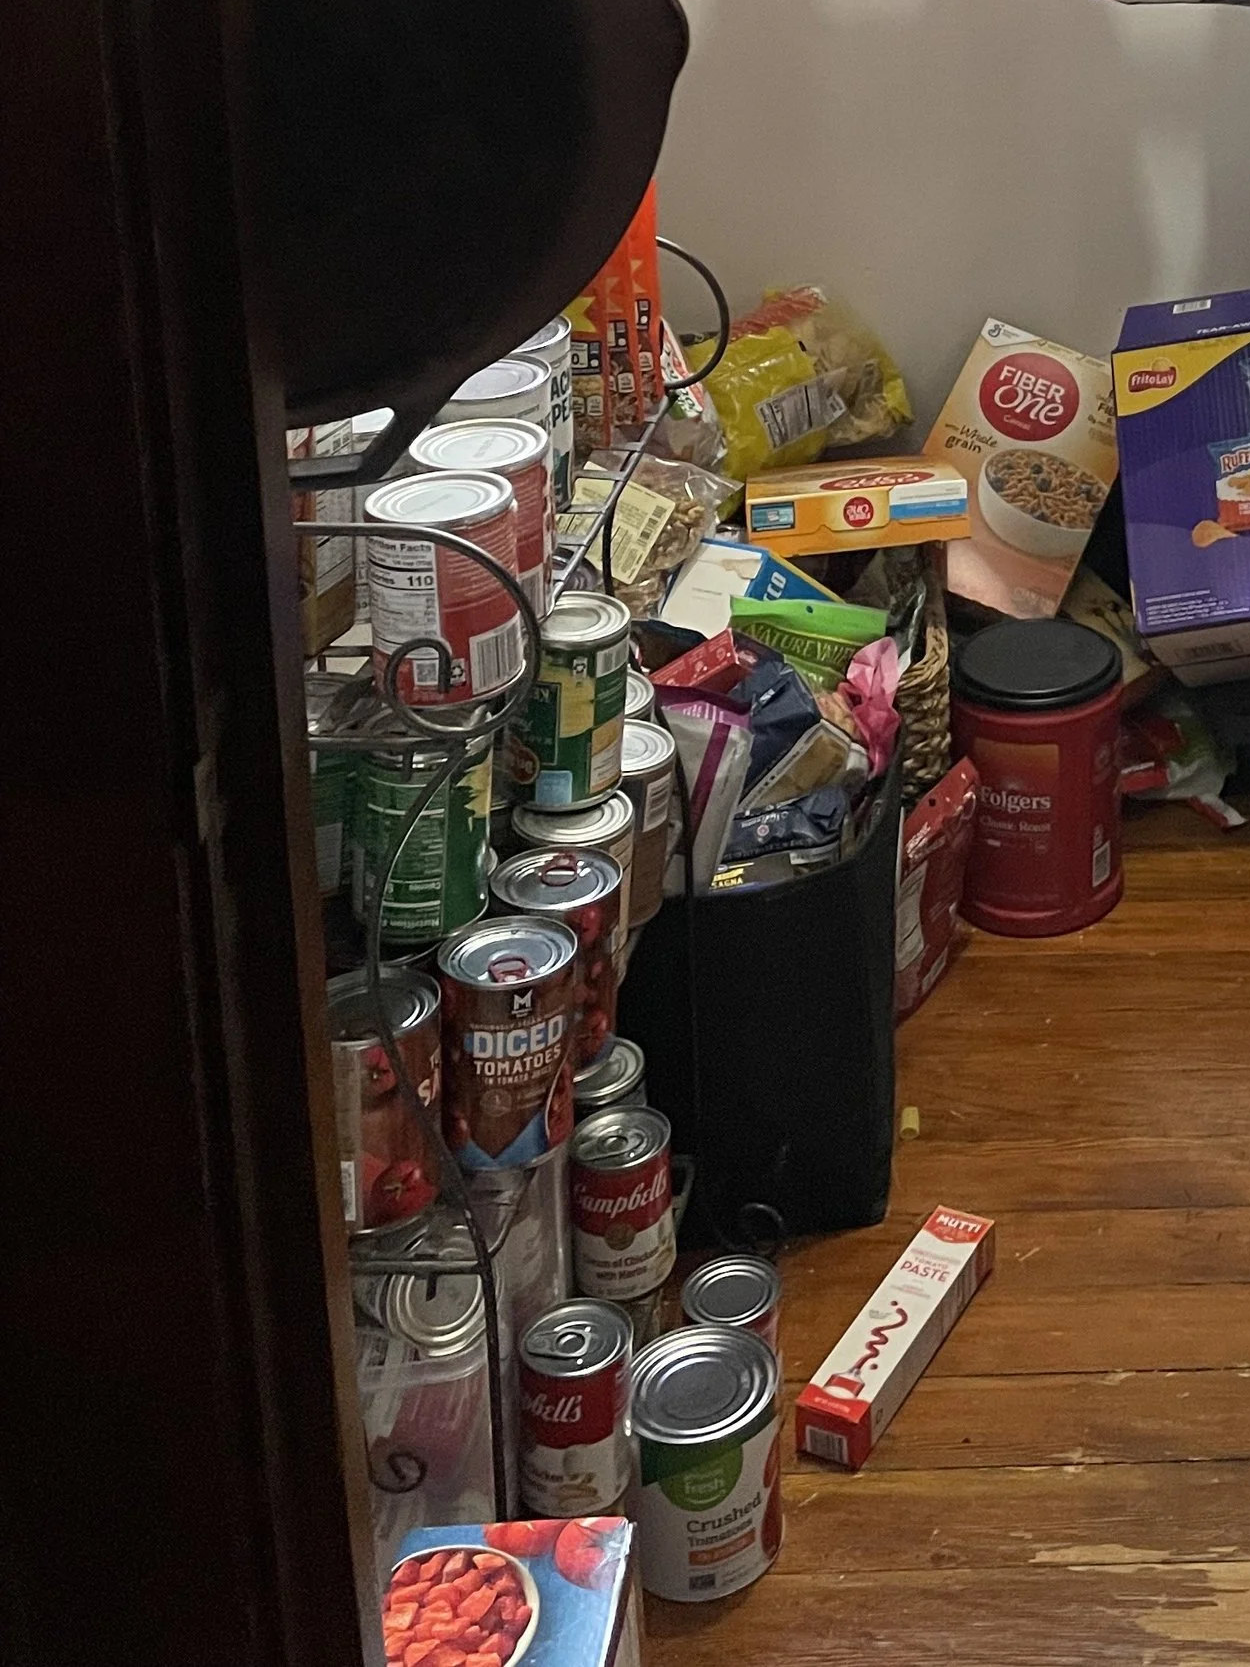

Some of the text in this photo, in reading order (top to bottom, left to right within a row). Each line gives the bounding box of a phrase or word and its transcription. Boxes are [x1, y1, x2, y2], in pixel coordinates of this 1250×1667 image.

[1000, 365, 1065, 404] FIBER
[944, 435, 982, 455] grain
[400, 543, 432, 552] Facts
[406, 575, 434, 587] 110
[979, 785, 1051, 814] Folgers
[513, 989, 533, 1010] M
[472, 1014, 564, 1059] DICED
[473, 1043, 562, 1076] TOMATOES
[936, 1213, 982, 1233] MUTTI
[900, 1260, 951, 1283] PASTE
[913, 1255, 950, 1269] TOMATO
[685, 1491, 762, 1535] Crushed
